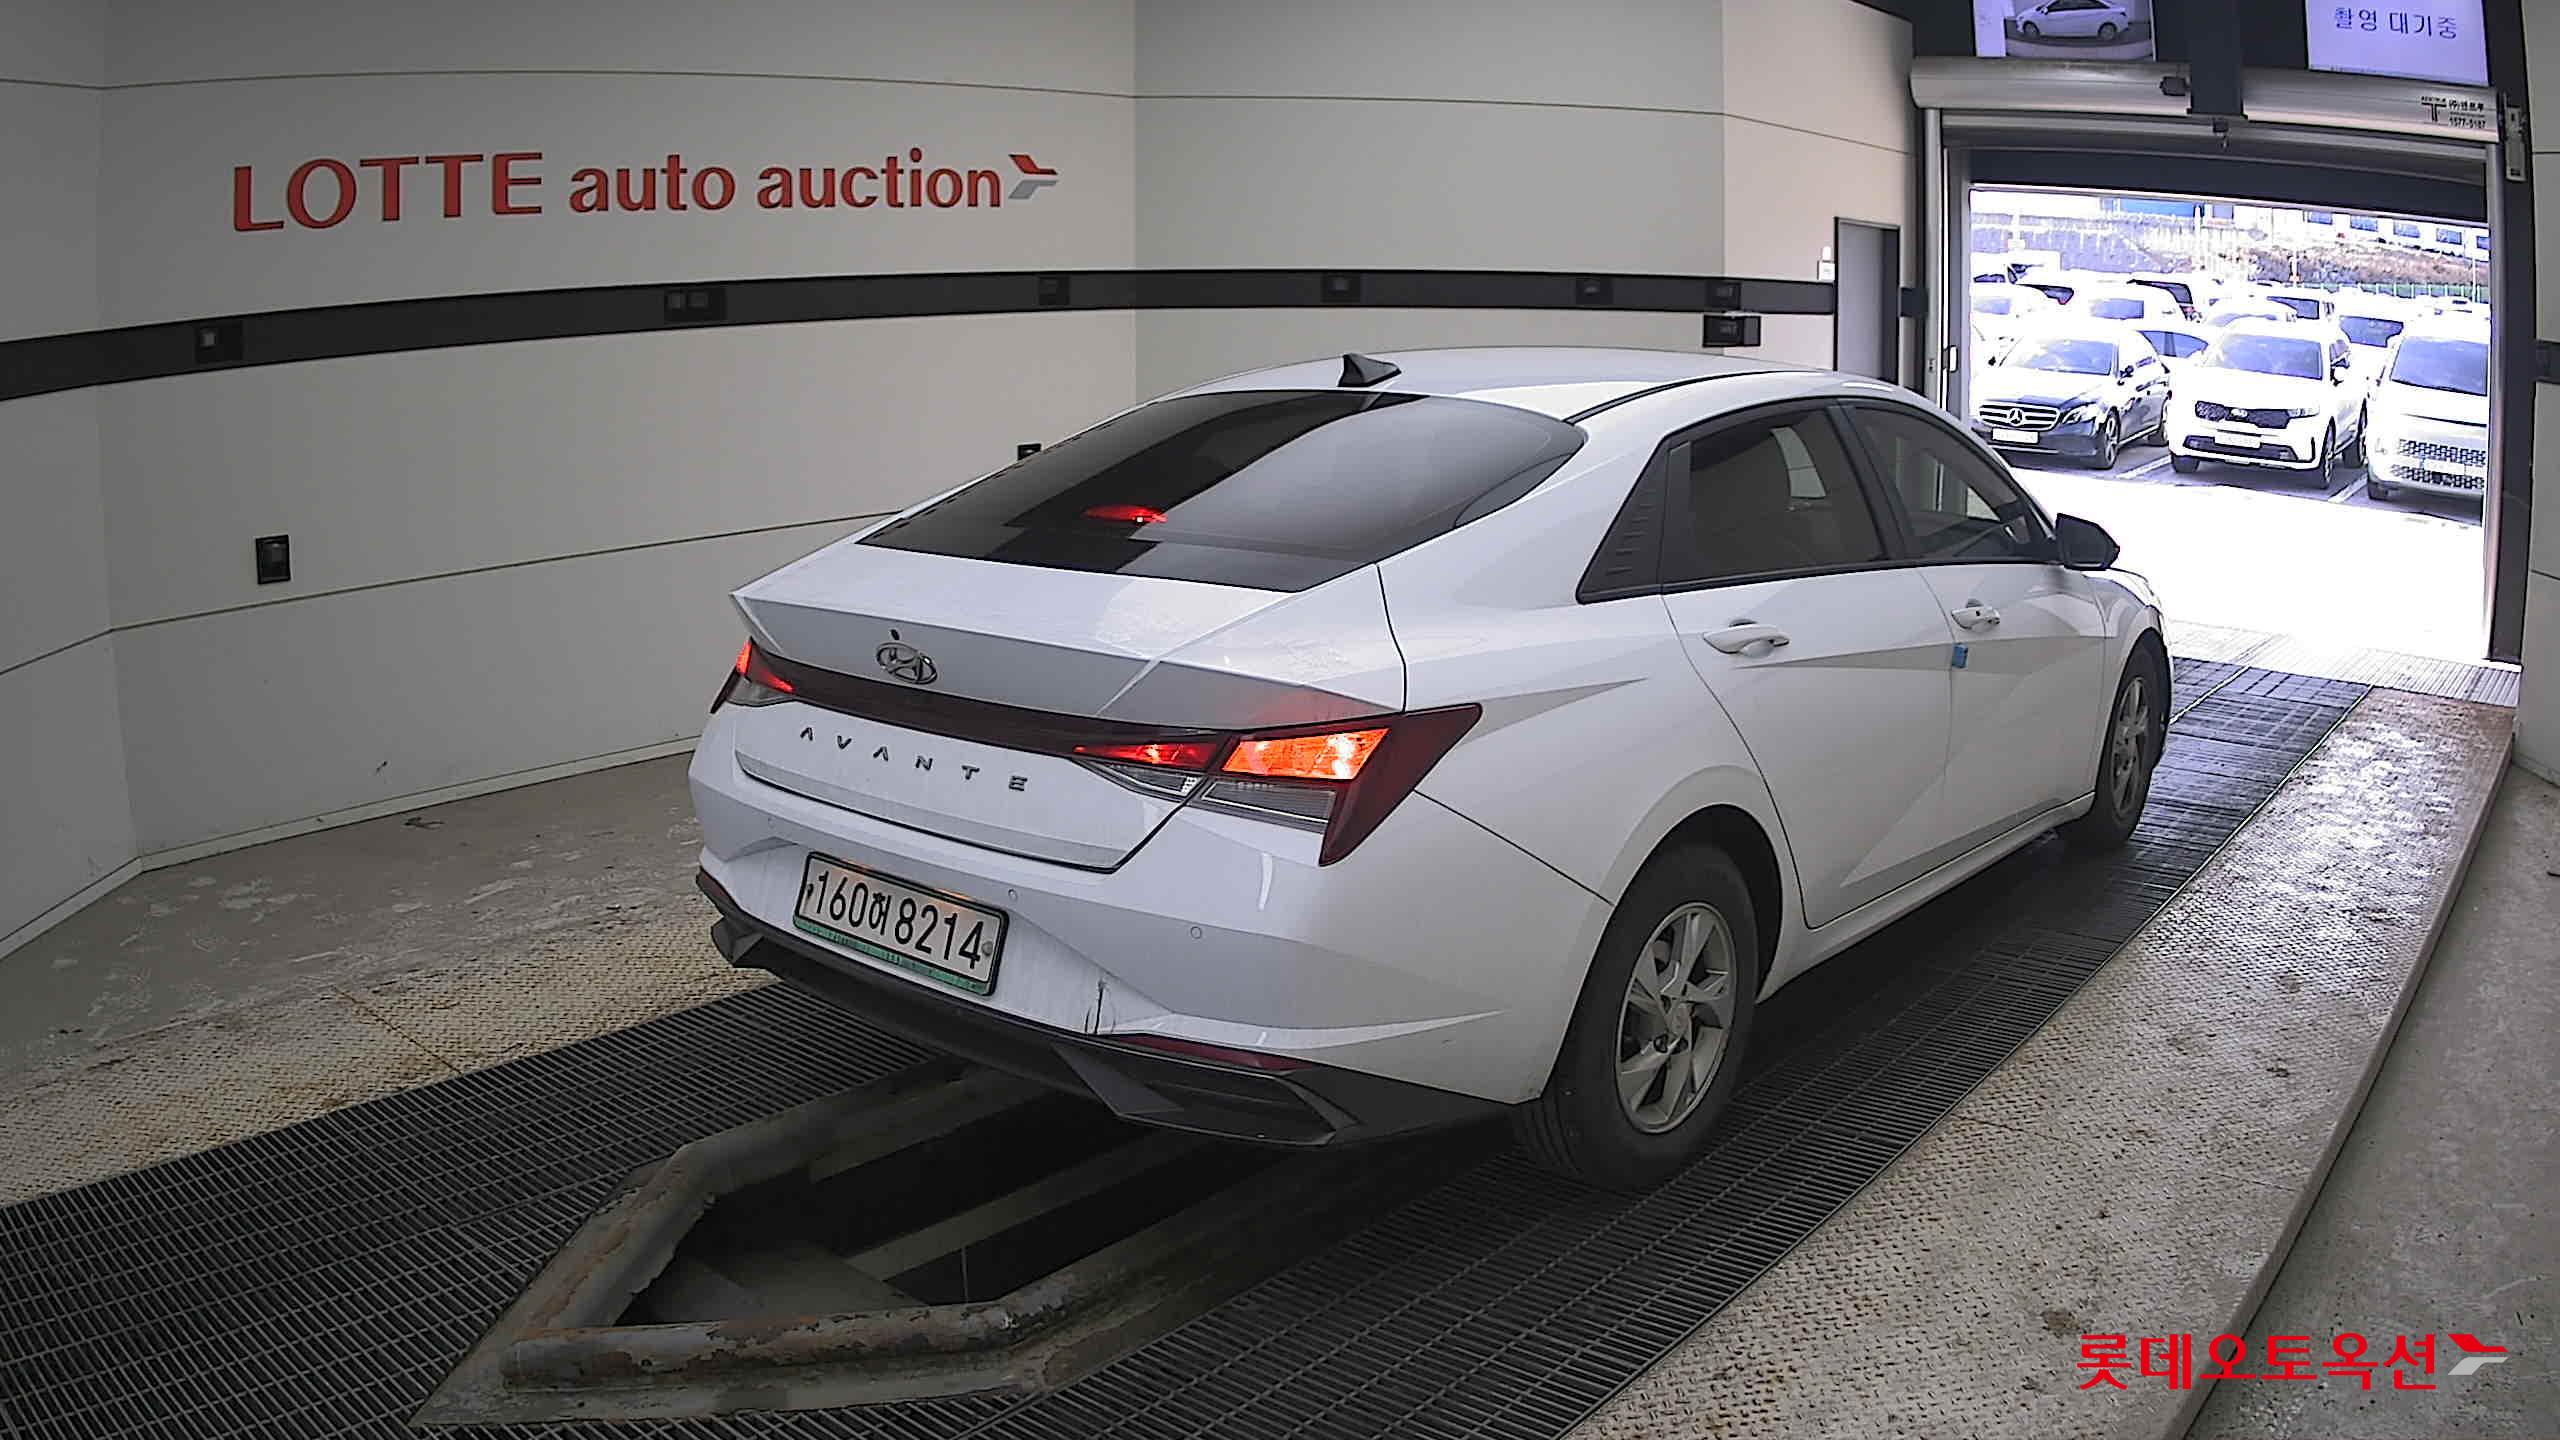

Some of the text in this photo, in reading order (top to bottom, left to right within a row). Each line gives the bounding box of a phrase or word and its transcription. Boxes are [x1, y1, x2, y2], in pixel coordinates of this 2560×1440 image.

[2389, 11, 2456, 39] 대기중
[233, 146, 1001, 232] LOTTE auto auction
[799, 726, 1028, 792] AVANTE
